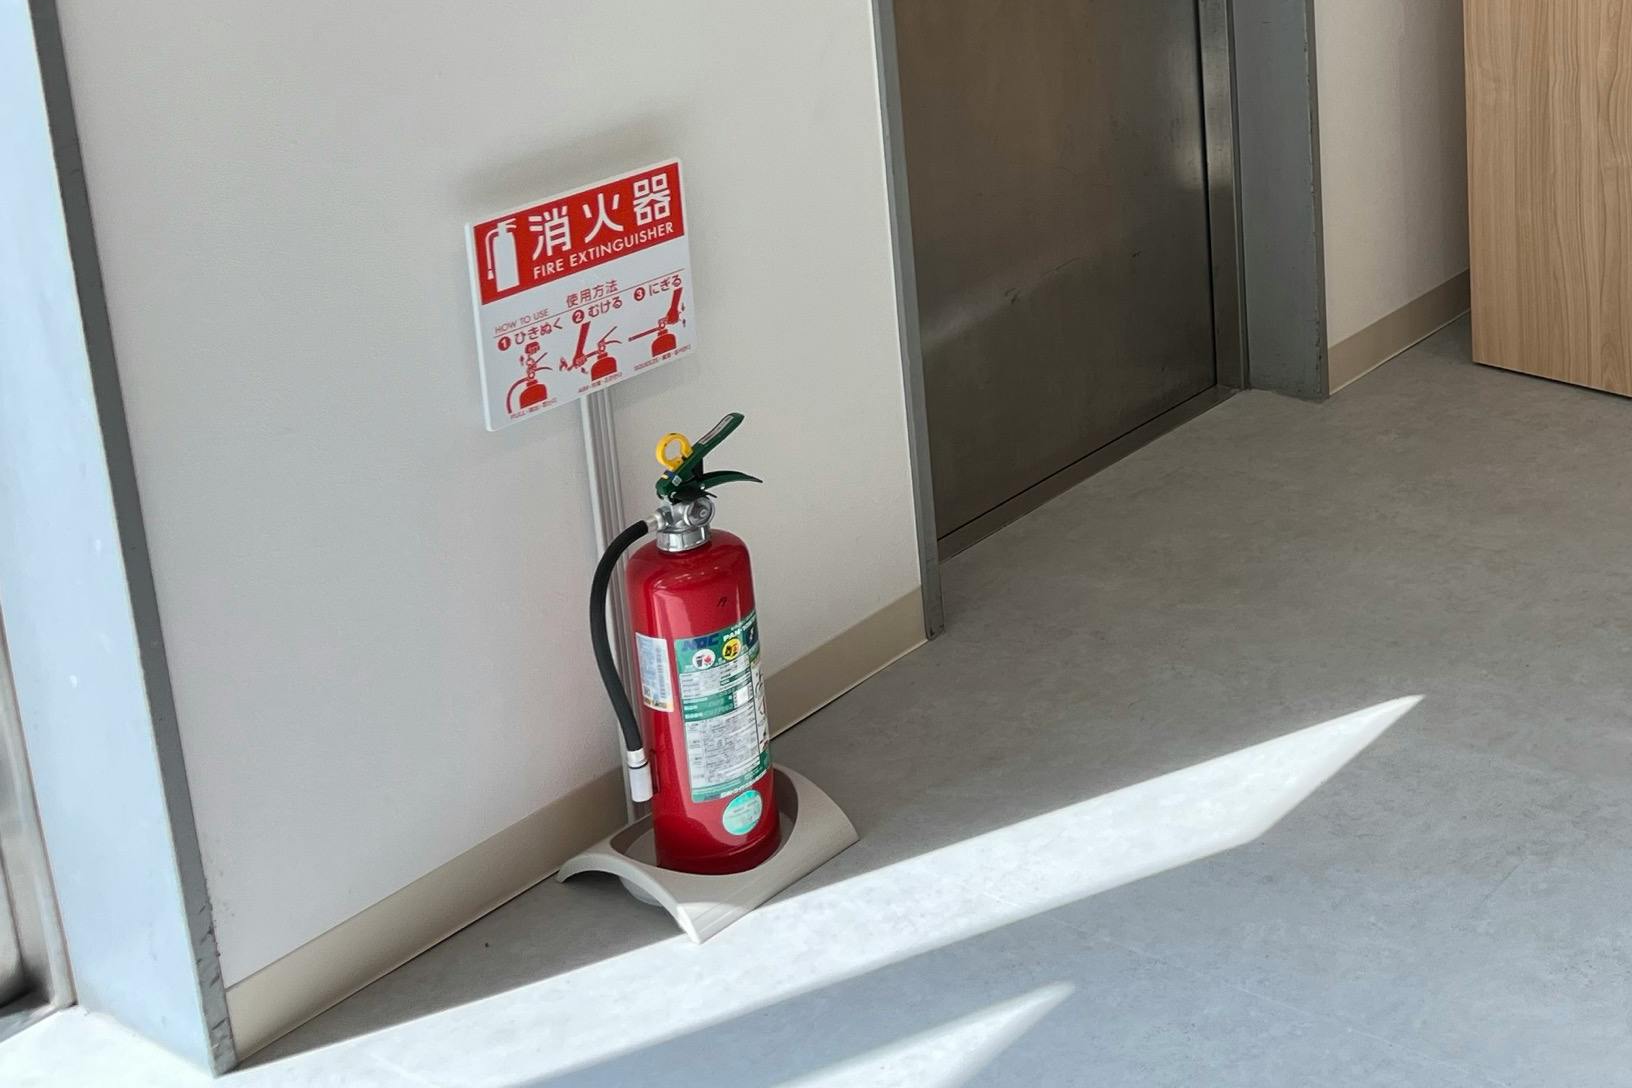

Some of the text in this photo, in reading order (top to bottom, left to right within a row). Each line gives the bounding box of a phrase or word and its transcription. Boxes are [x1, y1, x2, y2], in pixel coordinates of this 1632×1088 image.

[528, 173, 671, 261] 消火器
[533, 221, 674, 279] FIRE EXTINGUISHER
[566, 280, 619, 308] 使用方法
[649, 274, 682, 297] にぎる
[588, 296, 623, 318] むける
[495, 309, 548, 334] HOW TO USE
[514, 318, 563, 345] ひきぬく
